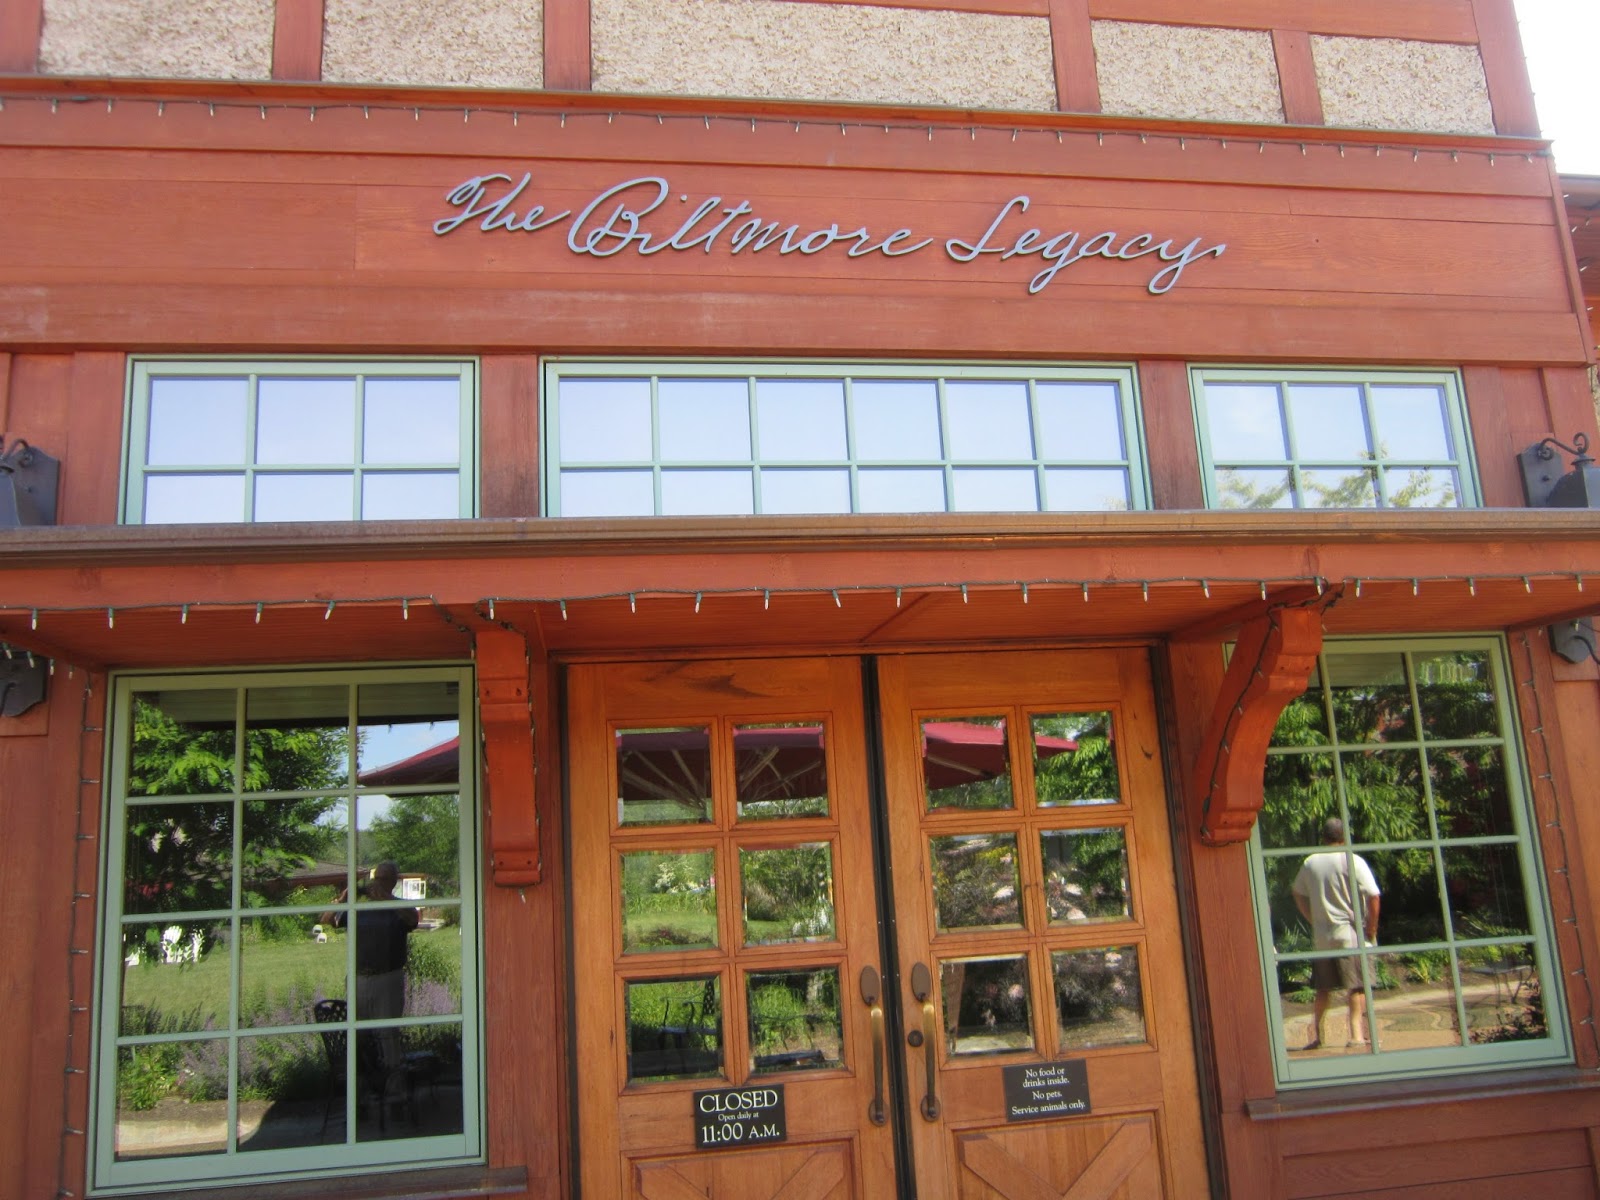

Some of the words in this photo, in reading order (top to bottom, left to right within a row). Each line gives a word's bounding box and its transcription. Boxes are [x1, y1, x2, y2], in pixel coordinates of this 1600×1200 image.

[433, 172, 571, 236] The
[567, 176, 934, 257] Biltmore
[945, 195, 1226, 294] Legacy
[1025, 1068, 1038, 1078] No
[1039, 1066, 1056, 1076] food
[1057, 1067, 1065, 1075] or
[1023, 1078, 1046, 1088] drinks
[1047, 1076, 1070, 1085] inside.
[699, 1089, 778, 1113] CLOSED
[1032, 1091, 1045, 1100] No
[1046, 1091, 1063, 1100] pets.
[1011, 1105, 1039, 1115] Service
[1040, 1101, 1068, 1112] animals
[1068, 1099, 1086, 1110] only.
[717, 1113, 736, 1122] Open
[736, 1111, 751, 1120] daily
[701, 1122, 743, 1143] 11:00
[748, 1123, 780, 1139] A.M.
